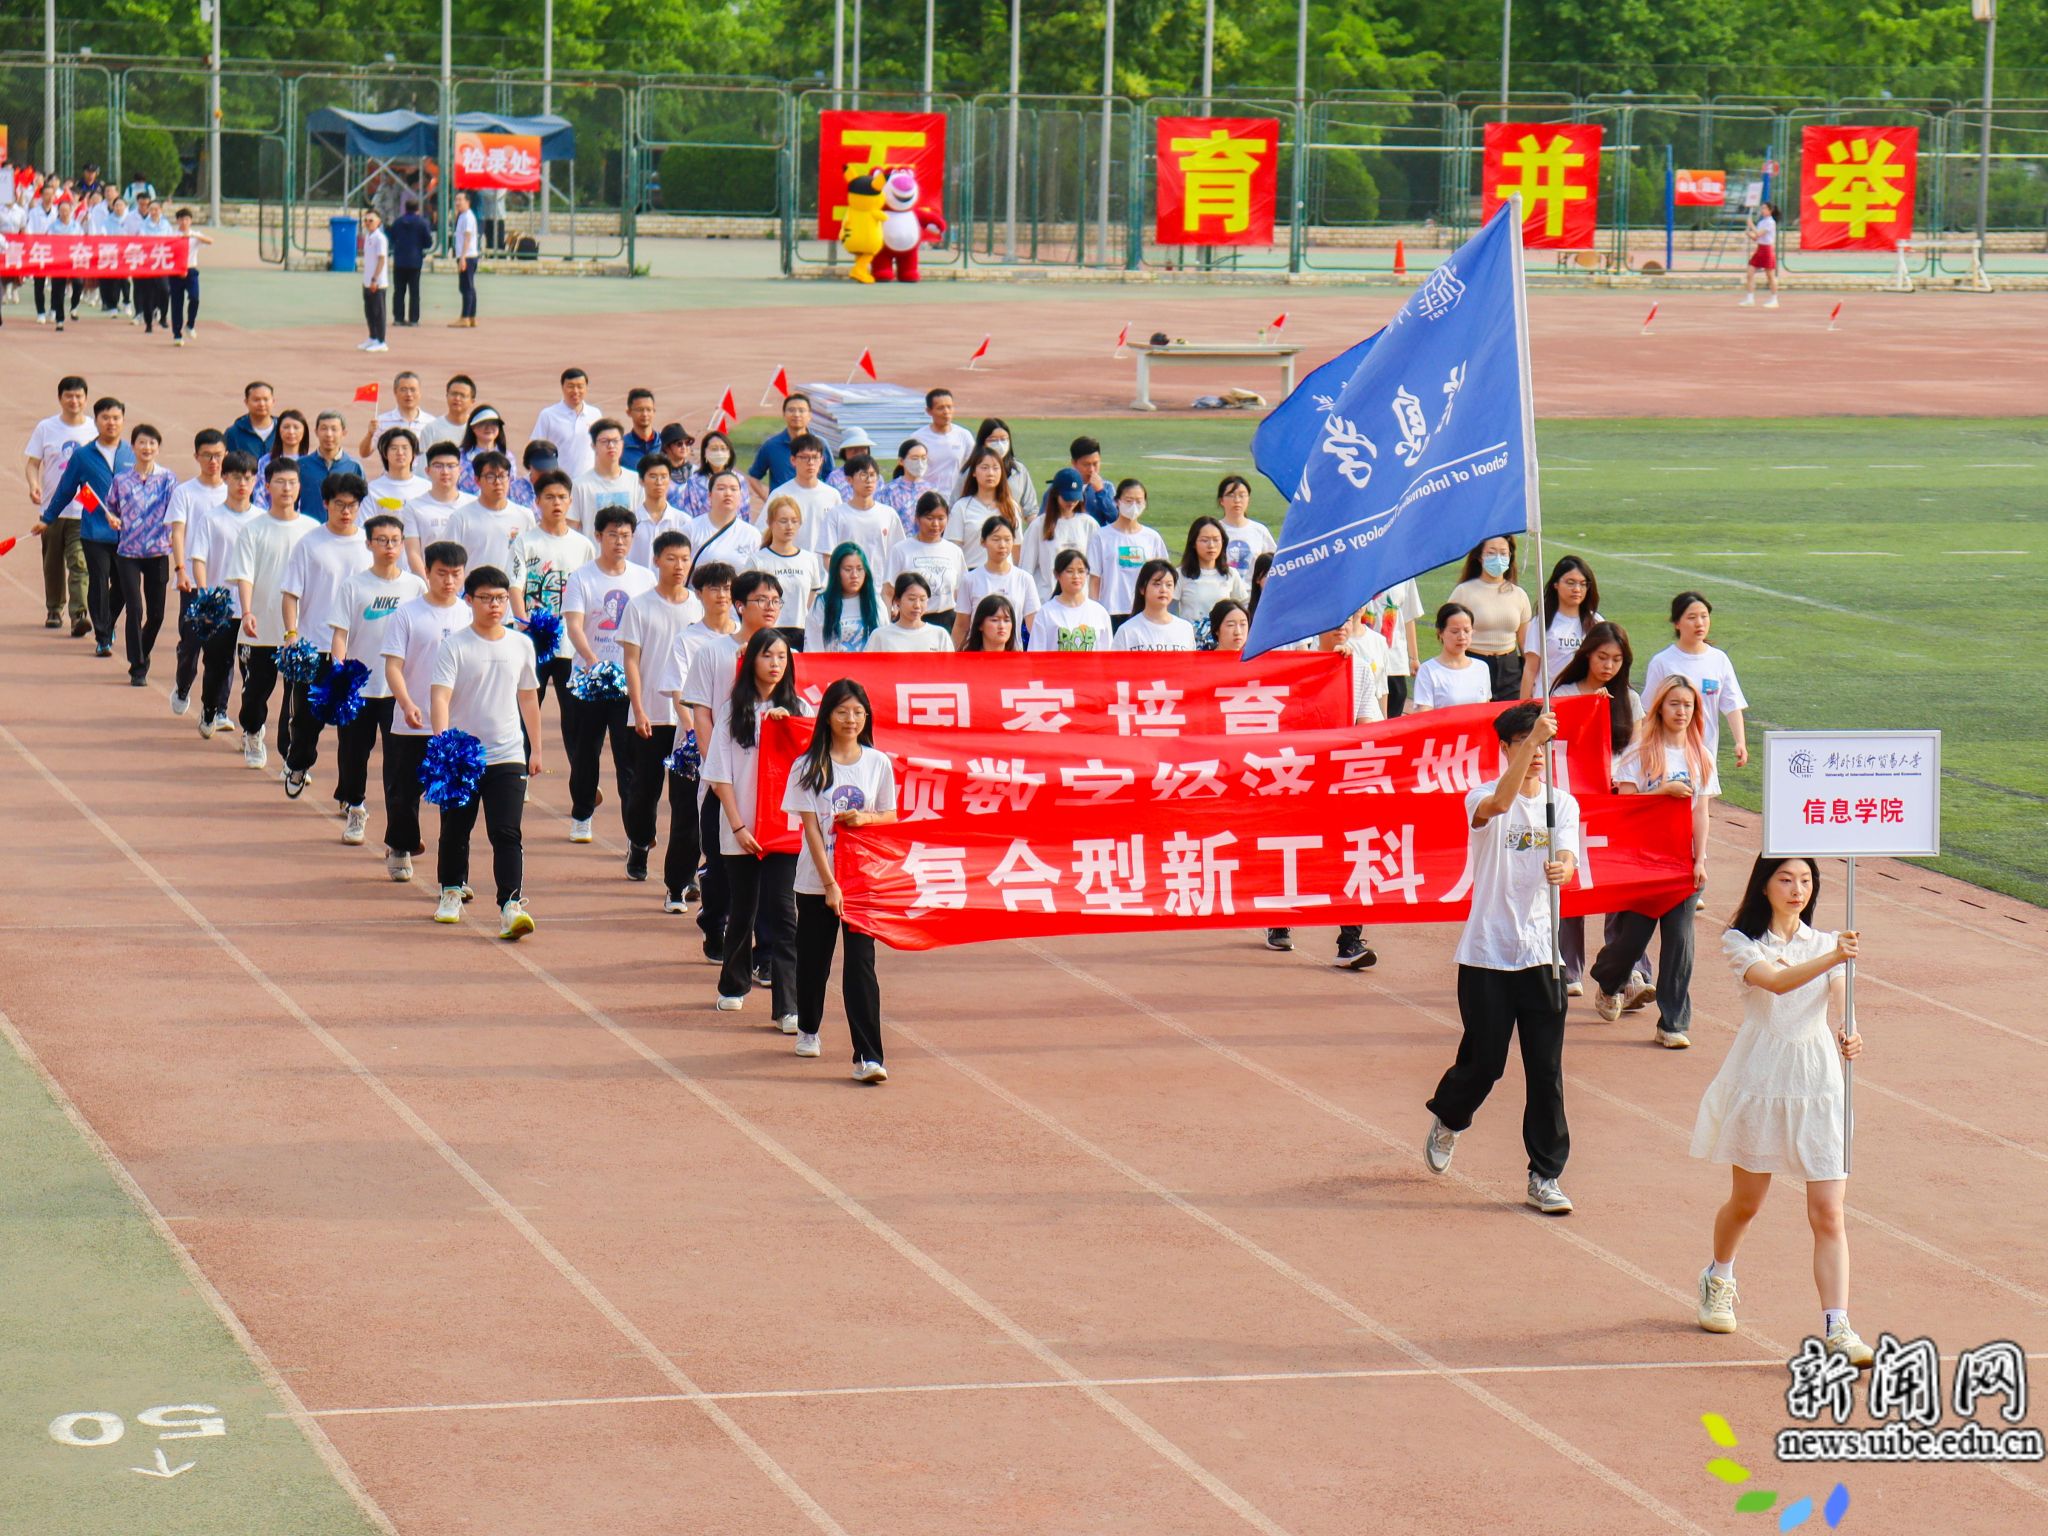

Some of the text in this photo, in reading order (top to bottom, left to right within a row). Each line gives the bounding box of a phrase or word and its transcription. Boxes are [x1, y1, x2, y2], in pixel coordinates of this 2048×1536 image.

[462, 146, 535, 175] 检录处
[1170, 129, 1267, 233] 育
[1496, 134, 1588, 237] 并
[1812, 138, 1906, 238] 举
[69, 242, 175, 271] 奋勇争先
[372, 596, 400, 609] NIKE
[803, 679, 1290, 737] 国家培育
[1802, 797, 1905, 825] 信息学院
